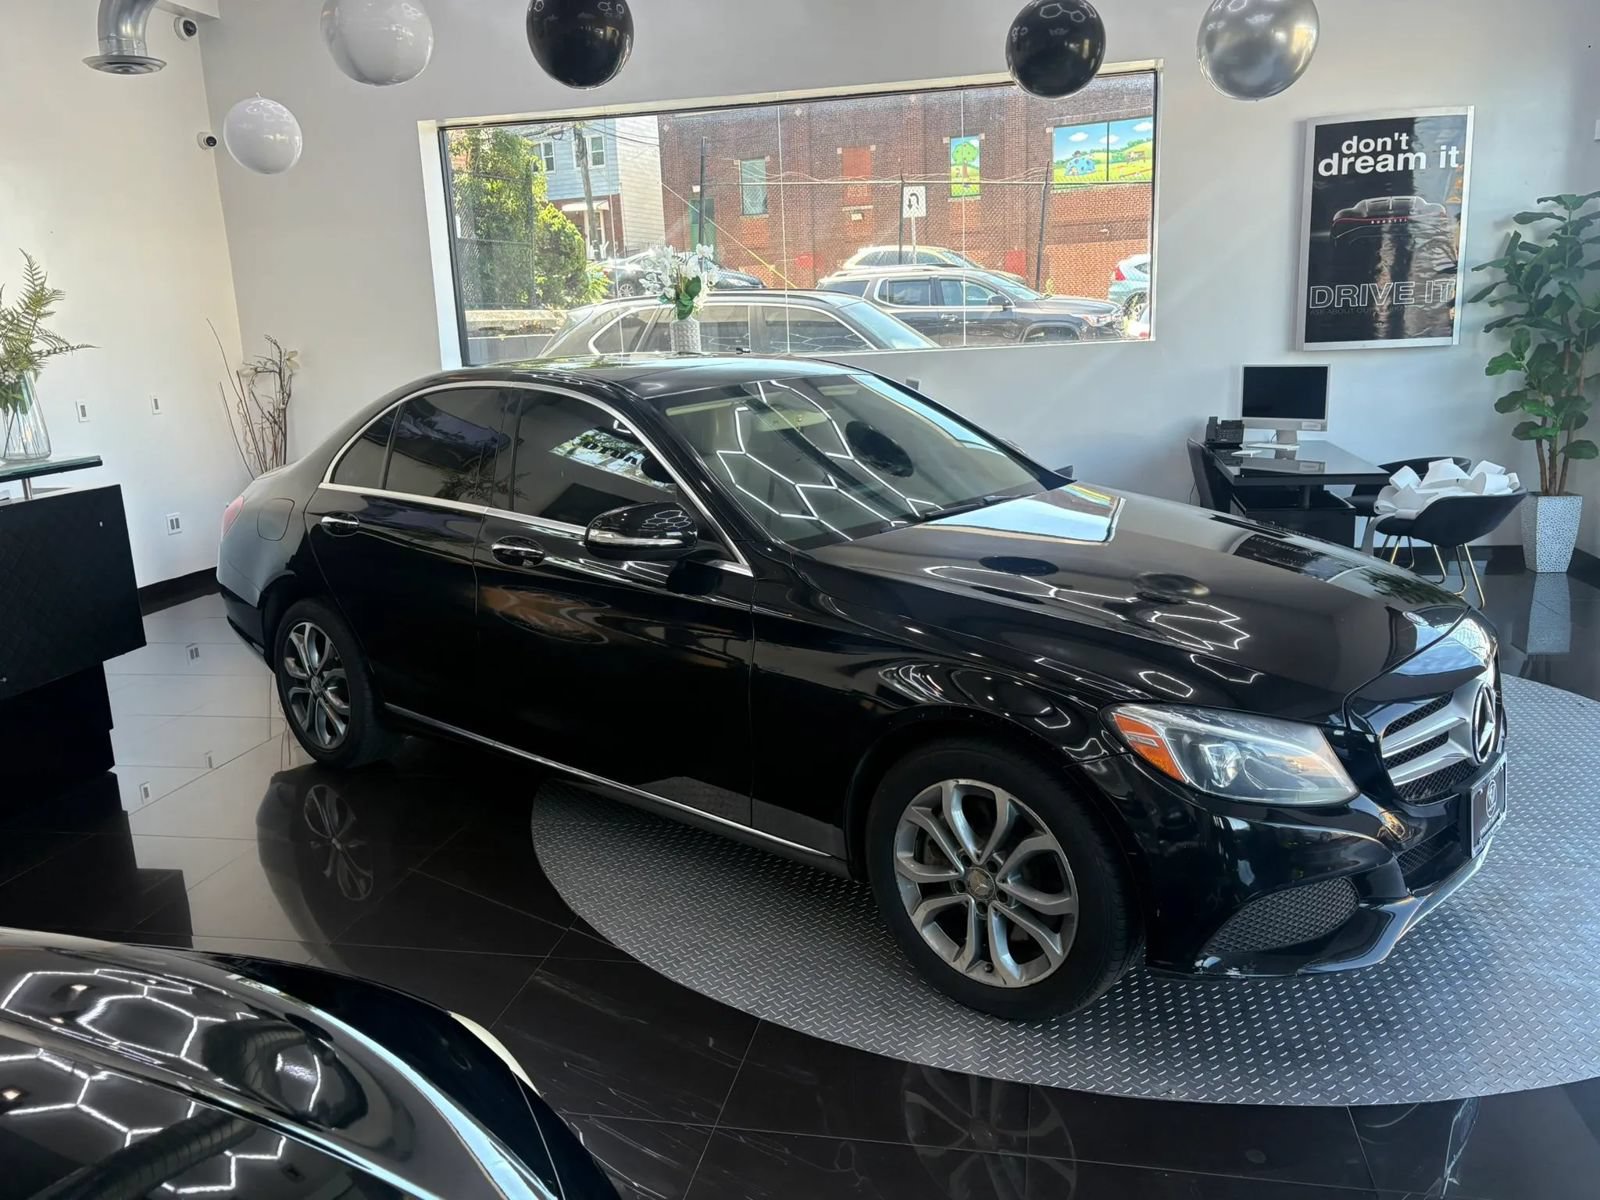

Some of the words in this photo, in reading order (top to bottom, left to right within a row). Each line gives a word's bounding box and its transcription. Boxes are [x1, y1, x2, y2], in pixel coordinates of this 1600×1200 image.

[1341, 132, 1409, 154] don't
[1318, 151, 1426, 176] dream
[1439, 145, 1460, 168] it
[1309, 281, 1415, 309] DRIVE
[1425, 279, 1456, 303] IT
